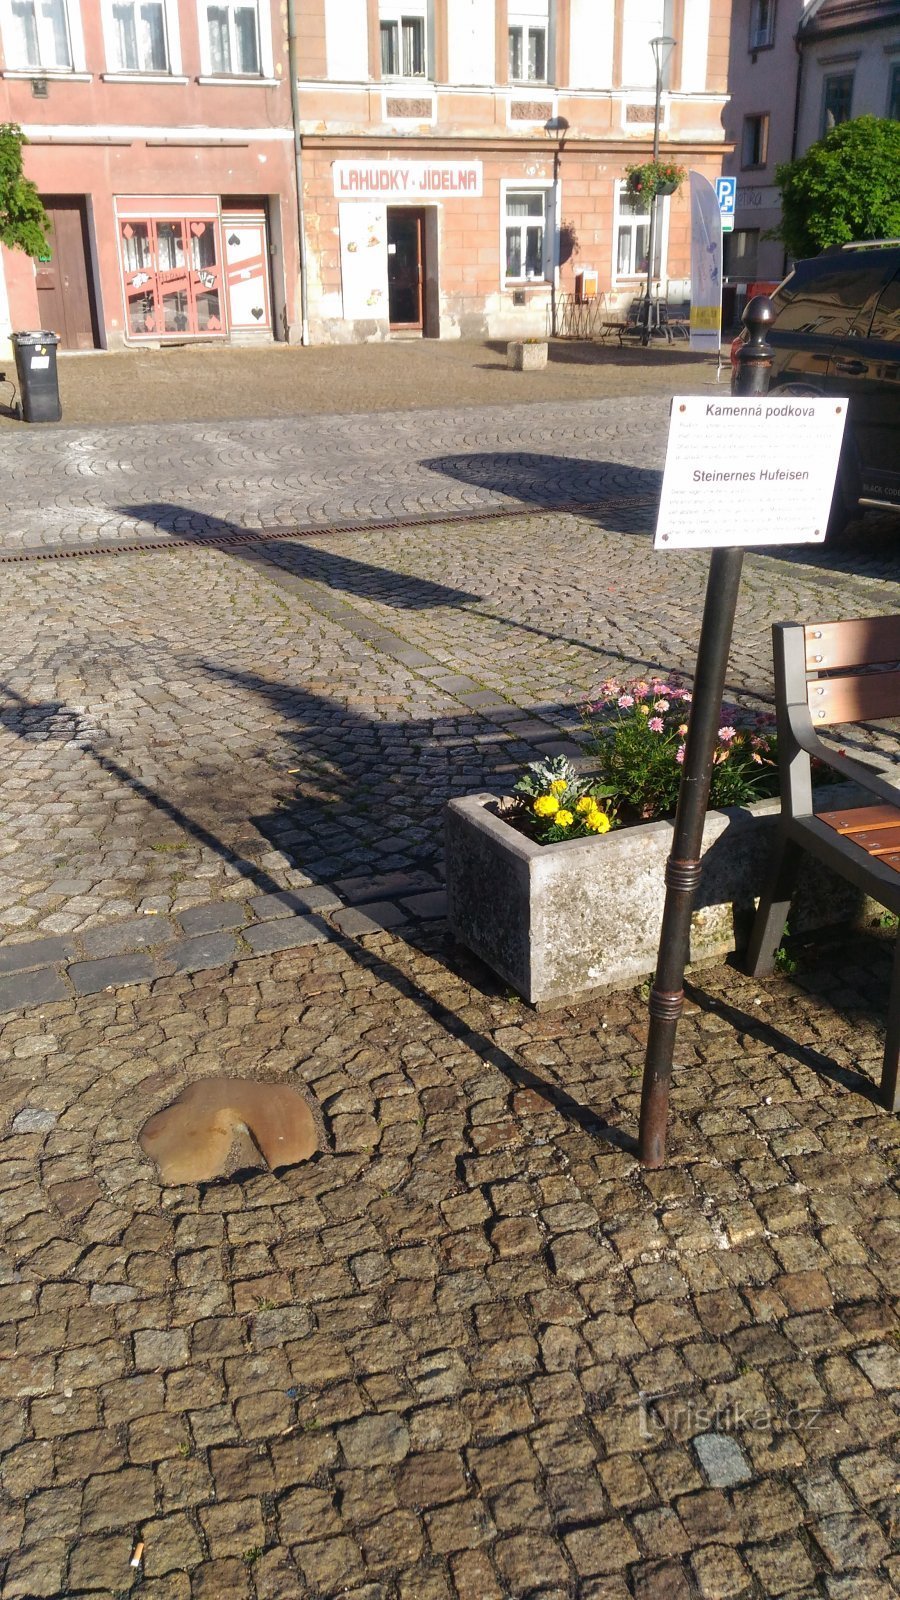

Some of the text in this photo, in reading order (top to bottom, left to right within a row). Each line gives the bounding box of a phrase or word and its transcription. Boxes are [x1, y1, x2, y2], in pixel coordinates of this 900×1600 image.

[340, 169, 409, 190] LAHUDKY
[719, 181, 731, 203] P
[706, 404, 815, 419] Kamenná podkova
[693, 469, 809, 482] Steinernes Hufeisen
